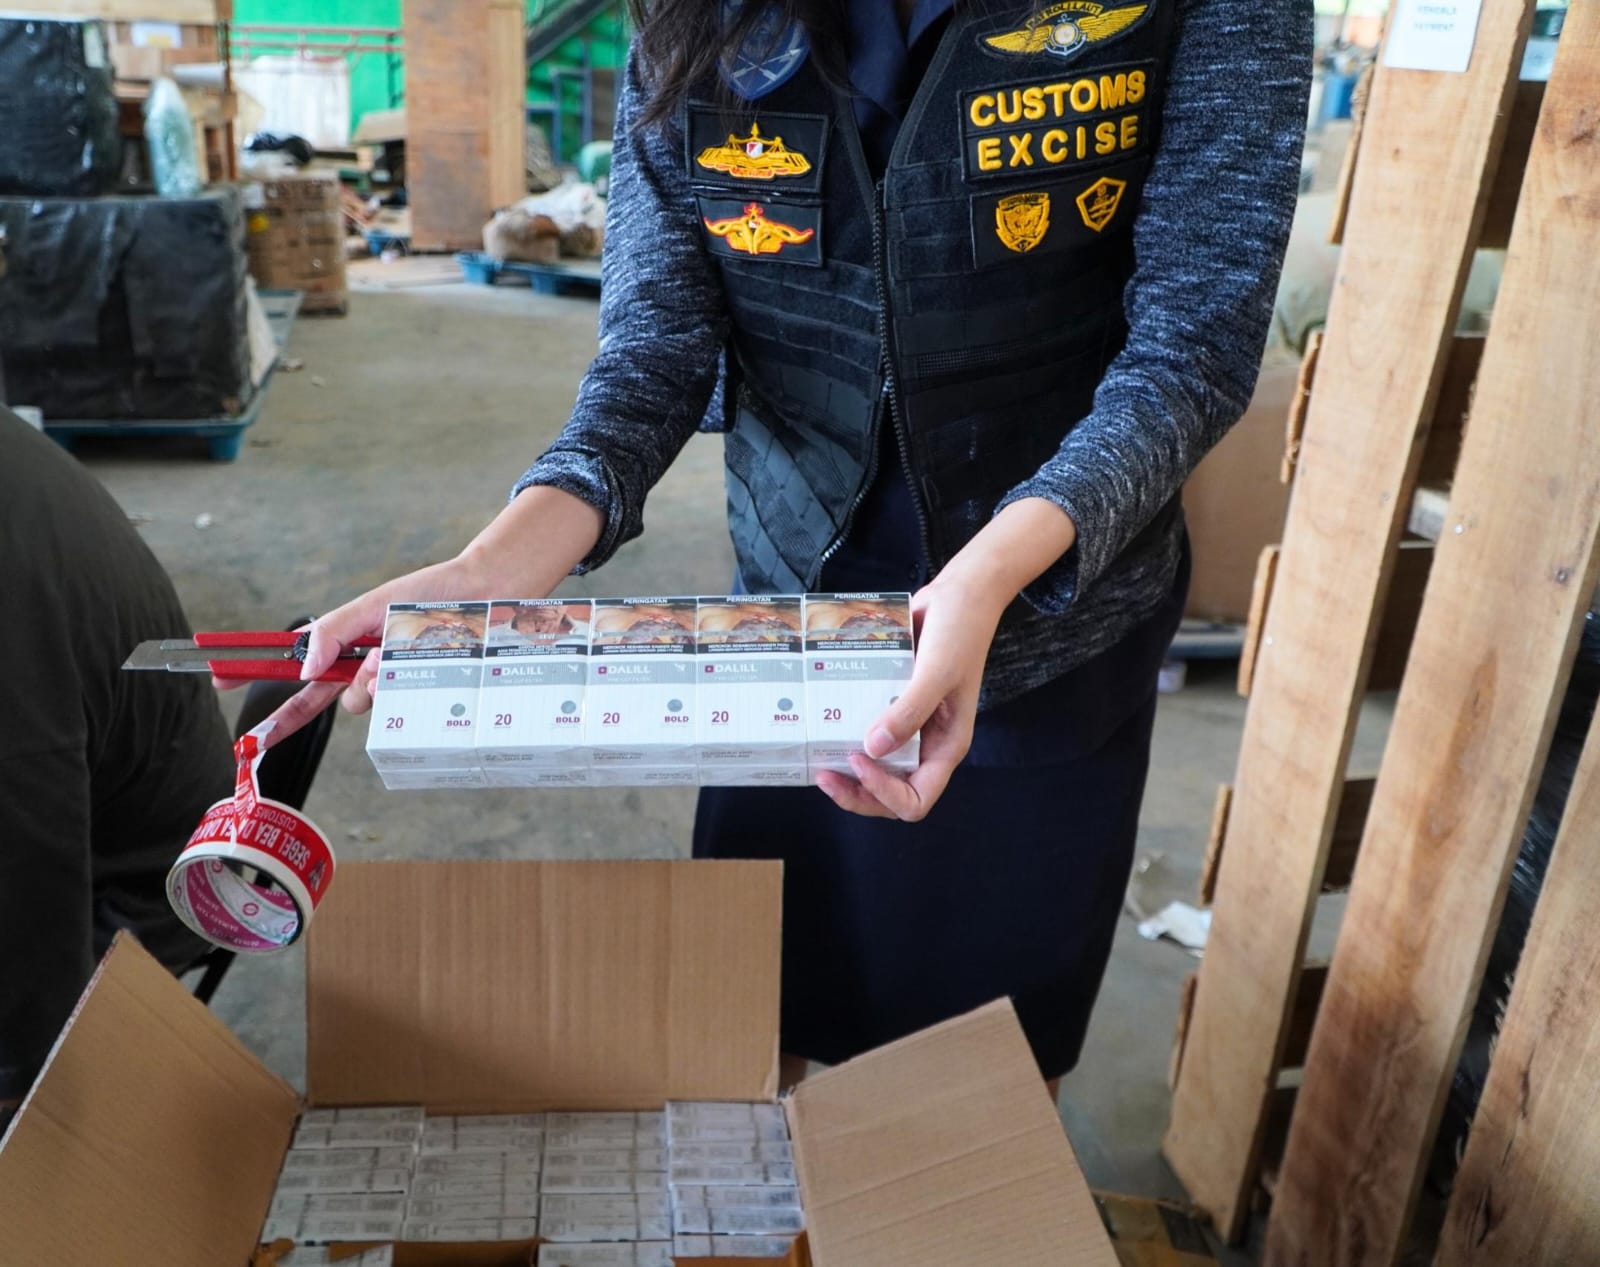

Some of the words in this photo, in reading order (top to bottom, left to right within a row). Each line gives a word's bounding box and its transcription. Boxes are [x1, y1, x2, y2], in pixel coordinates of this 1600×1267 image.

[970, 70, 1146, 127] CUSTOMS
[977, 115, 1139, 171] EXCISE
[502, 666, 543, 676] DALILL
[607, 665, 650, 674] DALILL
[714, 663, 757, 673] DALILL
[825, 661, 868, 671] DALILL
[395, 670, 437, 680] DALILL
[494, 713, 512, 726] 20
[603, 712, 620, 724] 20
[711, 711, 729, 723] 20
[823, 708, 841, 720] 20
[386, 717, 404, 729] 20
[255, 806, 297, 831] CUSTOMS
[254, 821, 281, 849] BEA
[278, 831, 311, 871] SEGEL
